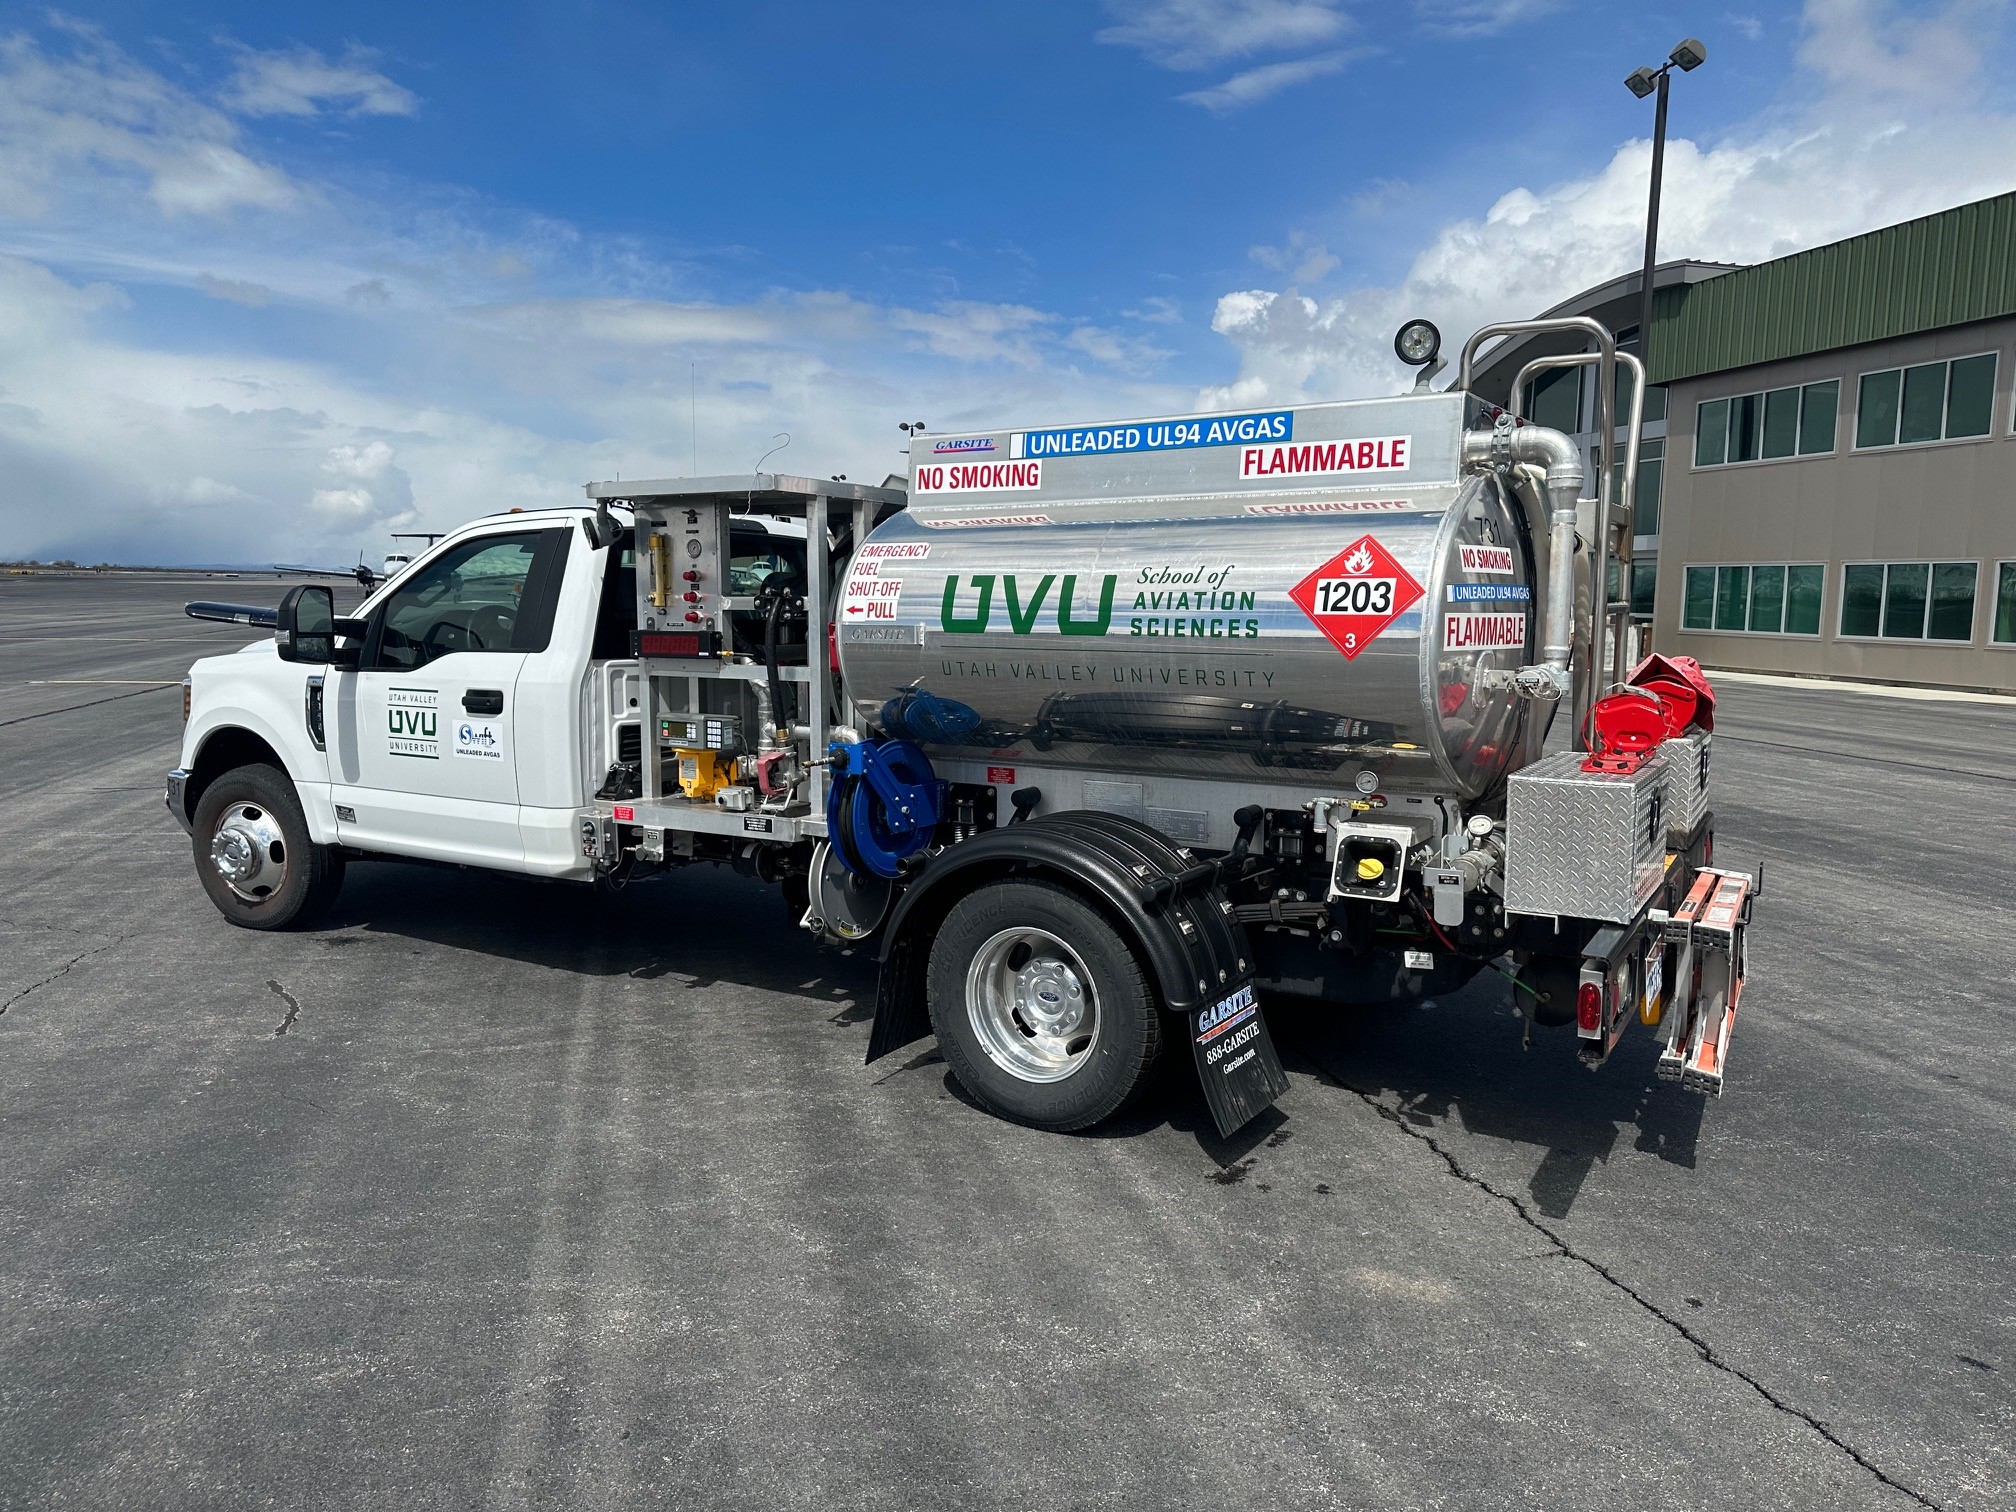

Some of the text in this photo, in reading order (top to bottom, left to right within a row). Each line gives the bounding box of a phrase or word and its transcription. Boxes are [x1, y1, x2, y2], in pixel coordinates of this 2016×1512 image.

[935, 438, 994, 450] GARSITE
[1031, 416, 1287, 455] UNLEADED UL94 AVGAS
[1244, 439, 1406, 476] FLAMMABLE
[917, 462, 1039, 490] NO SMOKING
[1474, 517, 1502, 545] 731
[860, 545, 930, 558] EMERGENCY
[1462, 548, 1512, 570] NO SMOKING
[853, 562, 878, 576] FUEL
[1137, 565, 1235, 590] School of
[849, 581, 901, 596] SHUT-OFF
[1319, 581, 1392, 613] 1203
[1456, 586, 1530, 600] UNLEADED UL94 AVGAS
[867, 602, 895, 619] PULL
[941, 575, 1117, 634] UVU
[1133, 591, 1255, 611] AVIATION
[852, 628, 905, 640] GARSITE
[1130, 617, 1259, 638] SCIENCES
[1447, 616, 1524, 647] FLAMMABLE
[1345, 633, 1356, 649] 3
[942, 661, 1275, 688] UTAH VALLEY UNIVERSITY
[388, 694, 437, 704] UTAH VALLEY
[389, 710, 436, 736] UVU
[390, 741, 438, 753] UNIVERSITY
[456, 748, 482, 756] UNLEADED
[1199, 985, 1253, 1032] GARSITE
[1206, 1021, 1260, 1065] 888-GARSITE
[1223, 1048, 1256, 1074] Garsite.com
